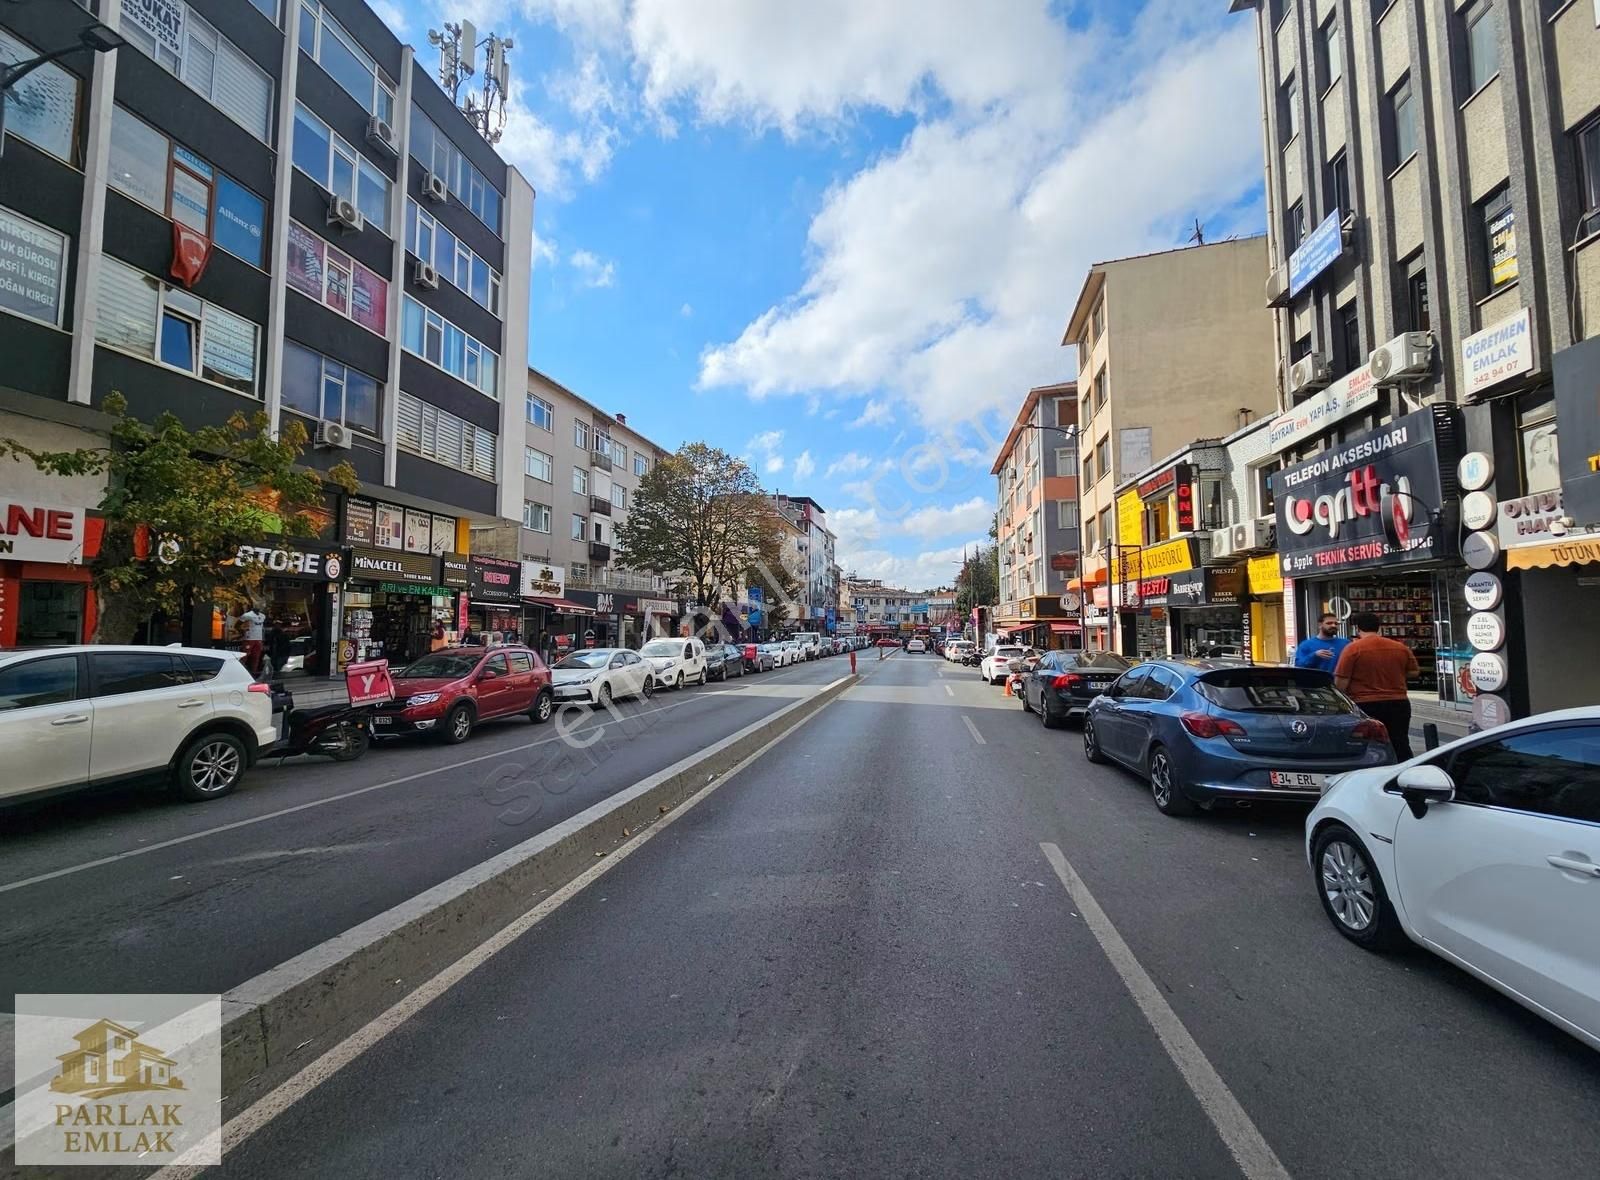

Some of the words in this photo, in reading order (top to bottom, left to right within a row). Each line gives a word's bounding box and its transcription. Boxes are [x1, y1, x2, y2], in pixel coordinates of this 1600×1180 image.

[219, 206, 250, 230] Allianz
[17, 246, 57, 271] BÜROSU
[28, 269, 56, 288] KIRGIZ
[26, 287, 55, 307] KIRGIZ
[1473, 342, 1518, 372] EMLAK
[1506, 360, 1519, 372] 07
[1348, 368, 1371, 389] EMLAK
[1271, 422, 1295, 444] BAYRAM
[1309, 406, 1324, 423] YAPI
[1285, 460, 1329, 488] TELEFON
[1331, 427, 1408, 470] AKSESUARI
[1294, 553, 1313, 569] Apple
[1315, 546, 1347, 567] TEKNİK
[1347, 539, 1383, 562] SERVİS
[1550, 541, 1595, 562] TÜTÜN
[483, 571, 510, 585] NEW
[361, 674, 376, 693] Y
[1279, 773, 1291, 784] 34
[1298, 775, 1317, 786] ERL
